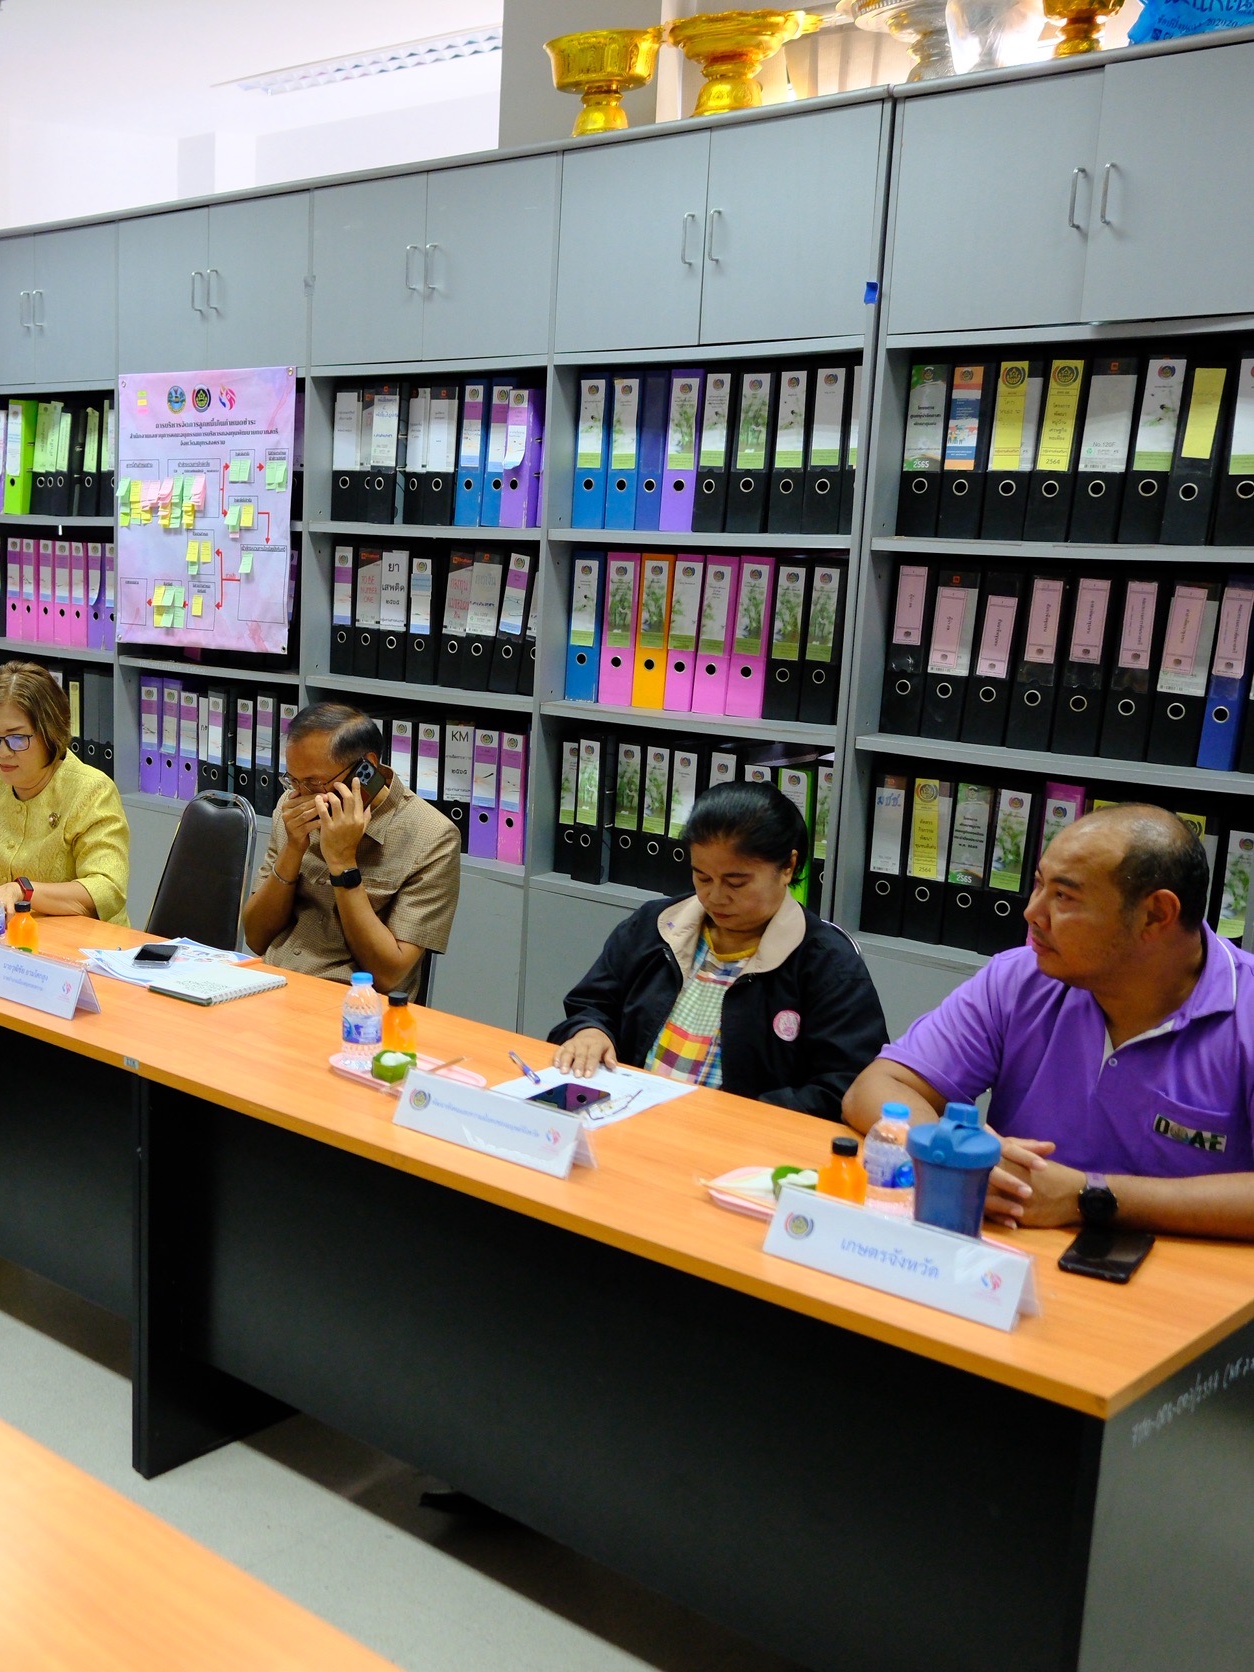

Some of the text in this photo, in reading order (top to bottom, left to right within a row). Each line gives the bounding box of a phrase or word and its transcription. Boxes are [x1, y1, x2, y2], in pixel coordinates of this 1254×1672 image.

[913, 459, 930, 468] 2565
[388, 562, 400, 572] ยา
[381, 582, 405, 592] เสพติด
[451, 730, 469, 742] KM
[840, 1234, 941, 1280] เกษตรจังหวัด
